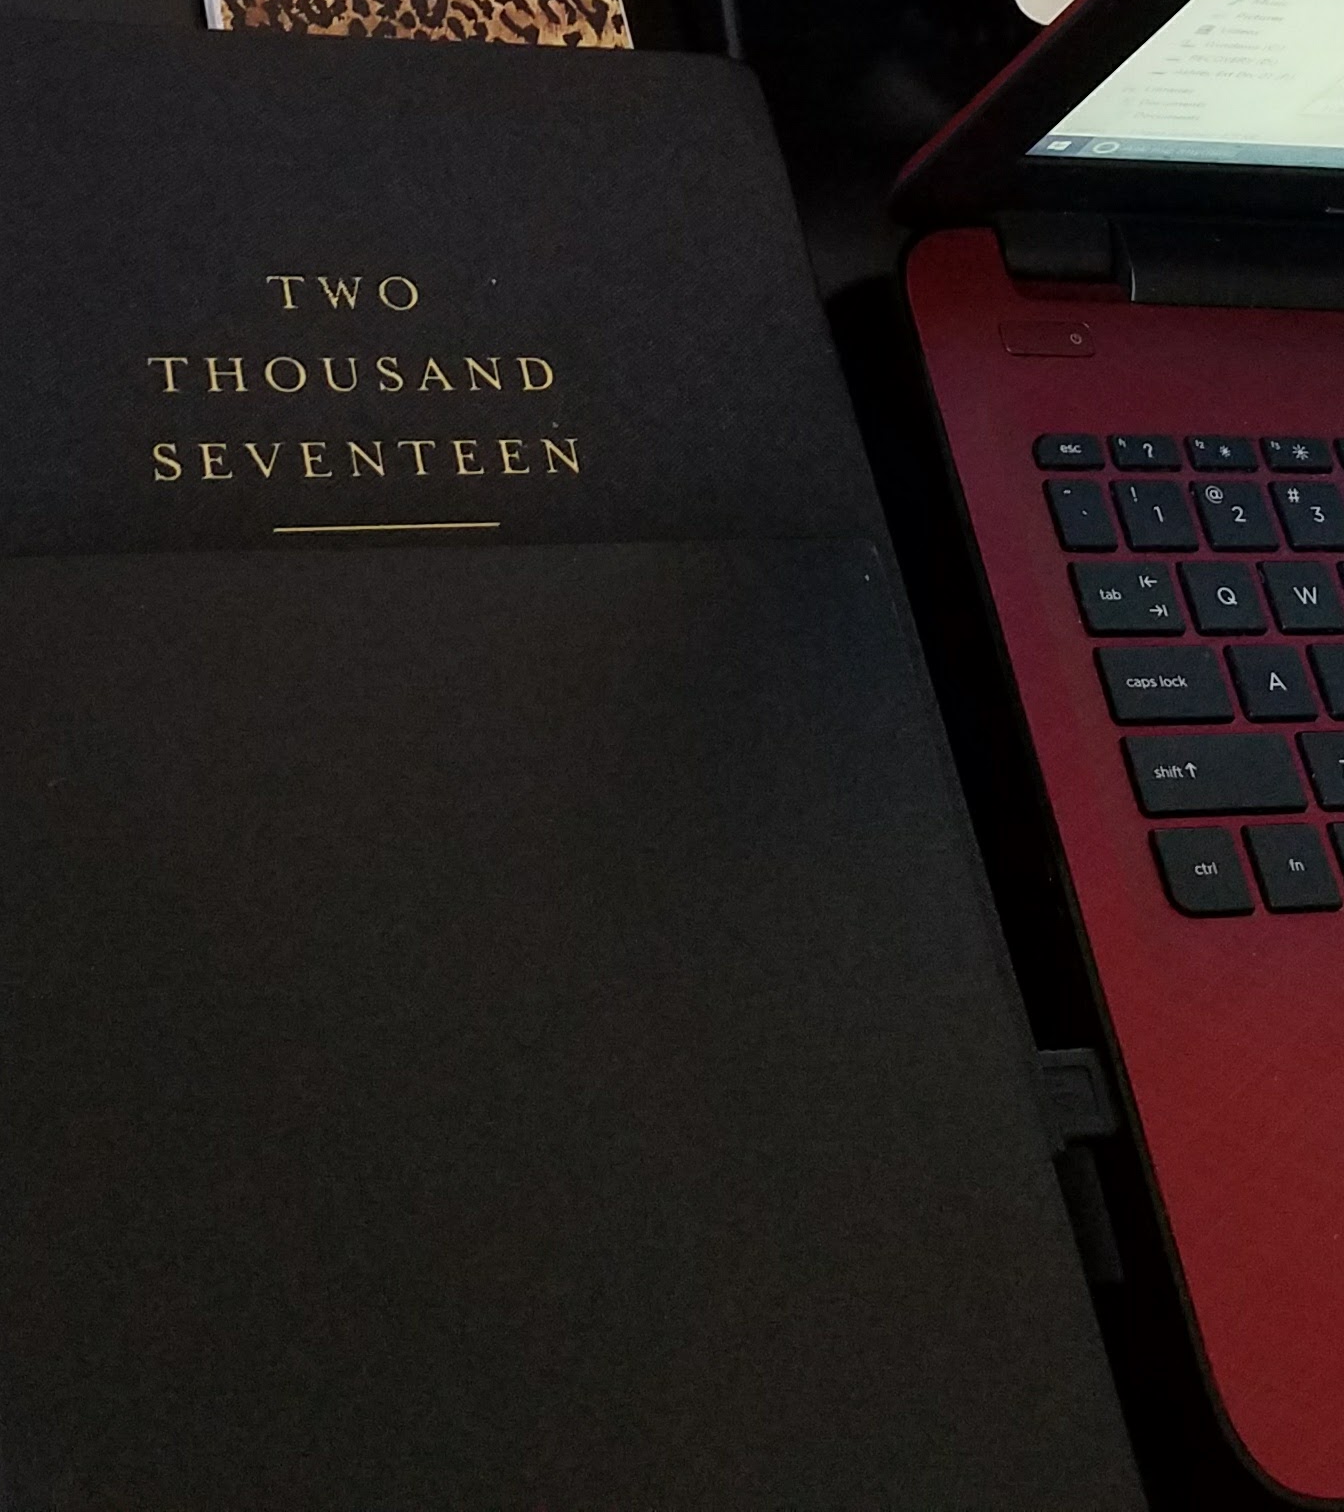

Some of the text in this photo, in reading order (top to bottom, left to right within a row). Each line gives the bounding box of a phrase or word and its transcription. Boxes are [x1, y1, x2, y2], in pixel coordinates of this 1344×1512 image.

[266, 275, 419, 311] TWO
[147, 356, 553, 393] THOUSAND
[1059, 444, 1082, 454] esc
[153, 438, 579, 481] SEVENTEEN
[1231, 506, 1247, 523] 2
[1310, 506, 1325, 523] 3
[1099, 588, 1122, 601] tab
[1217, 587, 1238, 605] Q
[1293, 586, 1317, 605] W
[1126, 678, 1158, 689] caps
[1158, 675, 1188, 688] lock
[1269, 672, 1287, 691] A
[1153, 765, 1184, 779] shift
[1194, 861, 1218, 876] ctrl
[1289, 858, 1305, 871] fn
